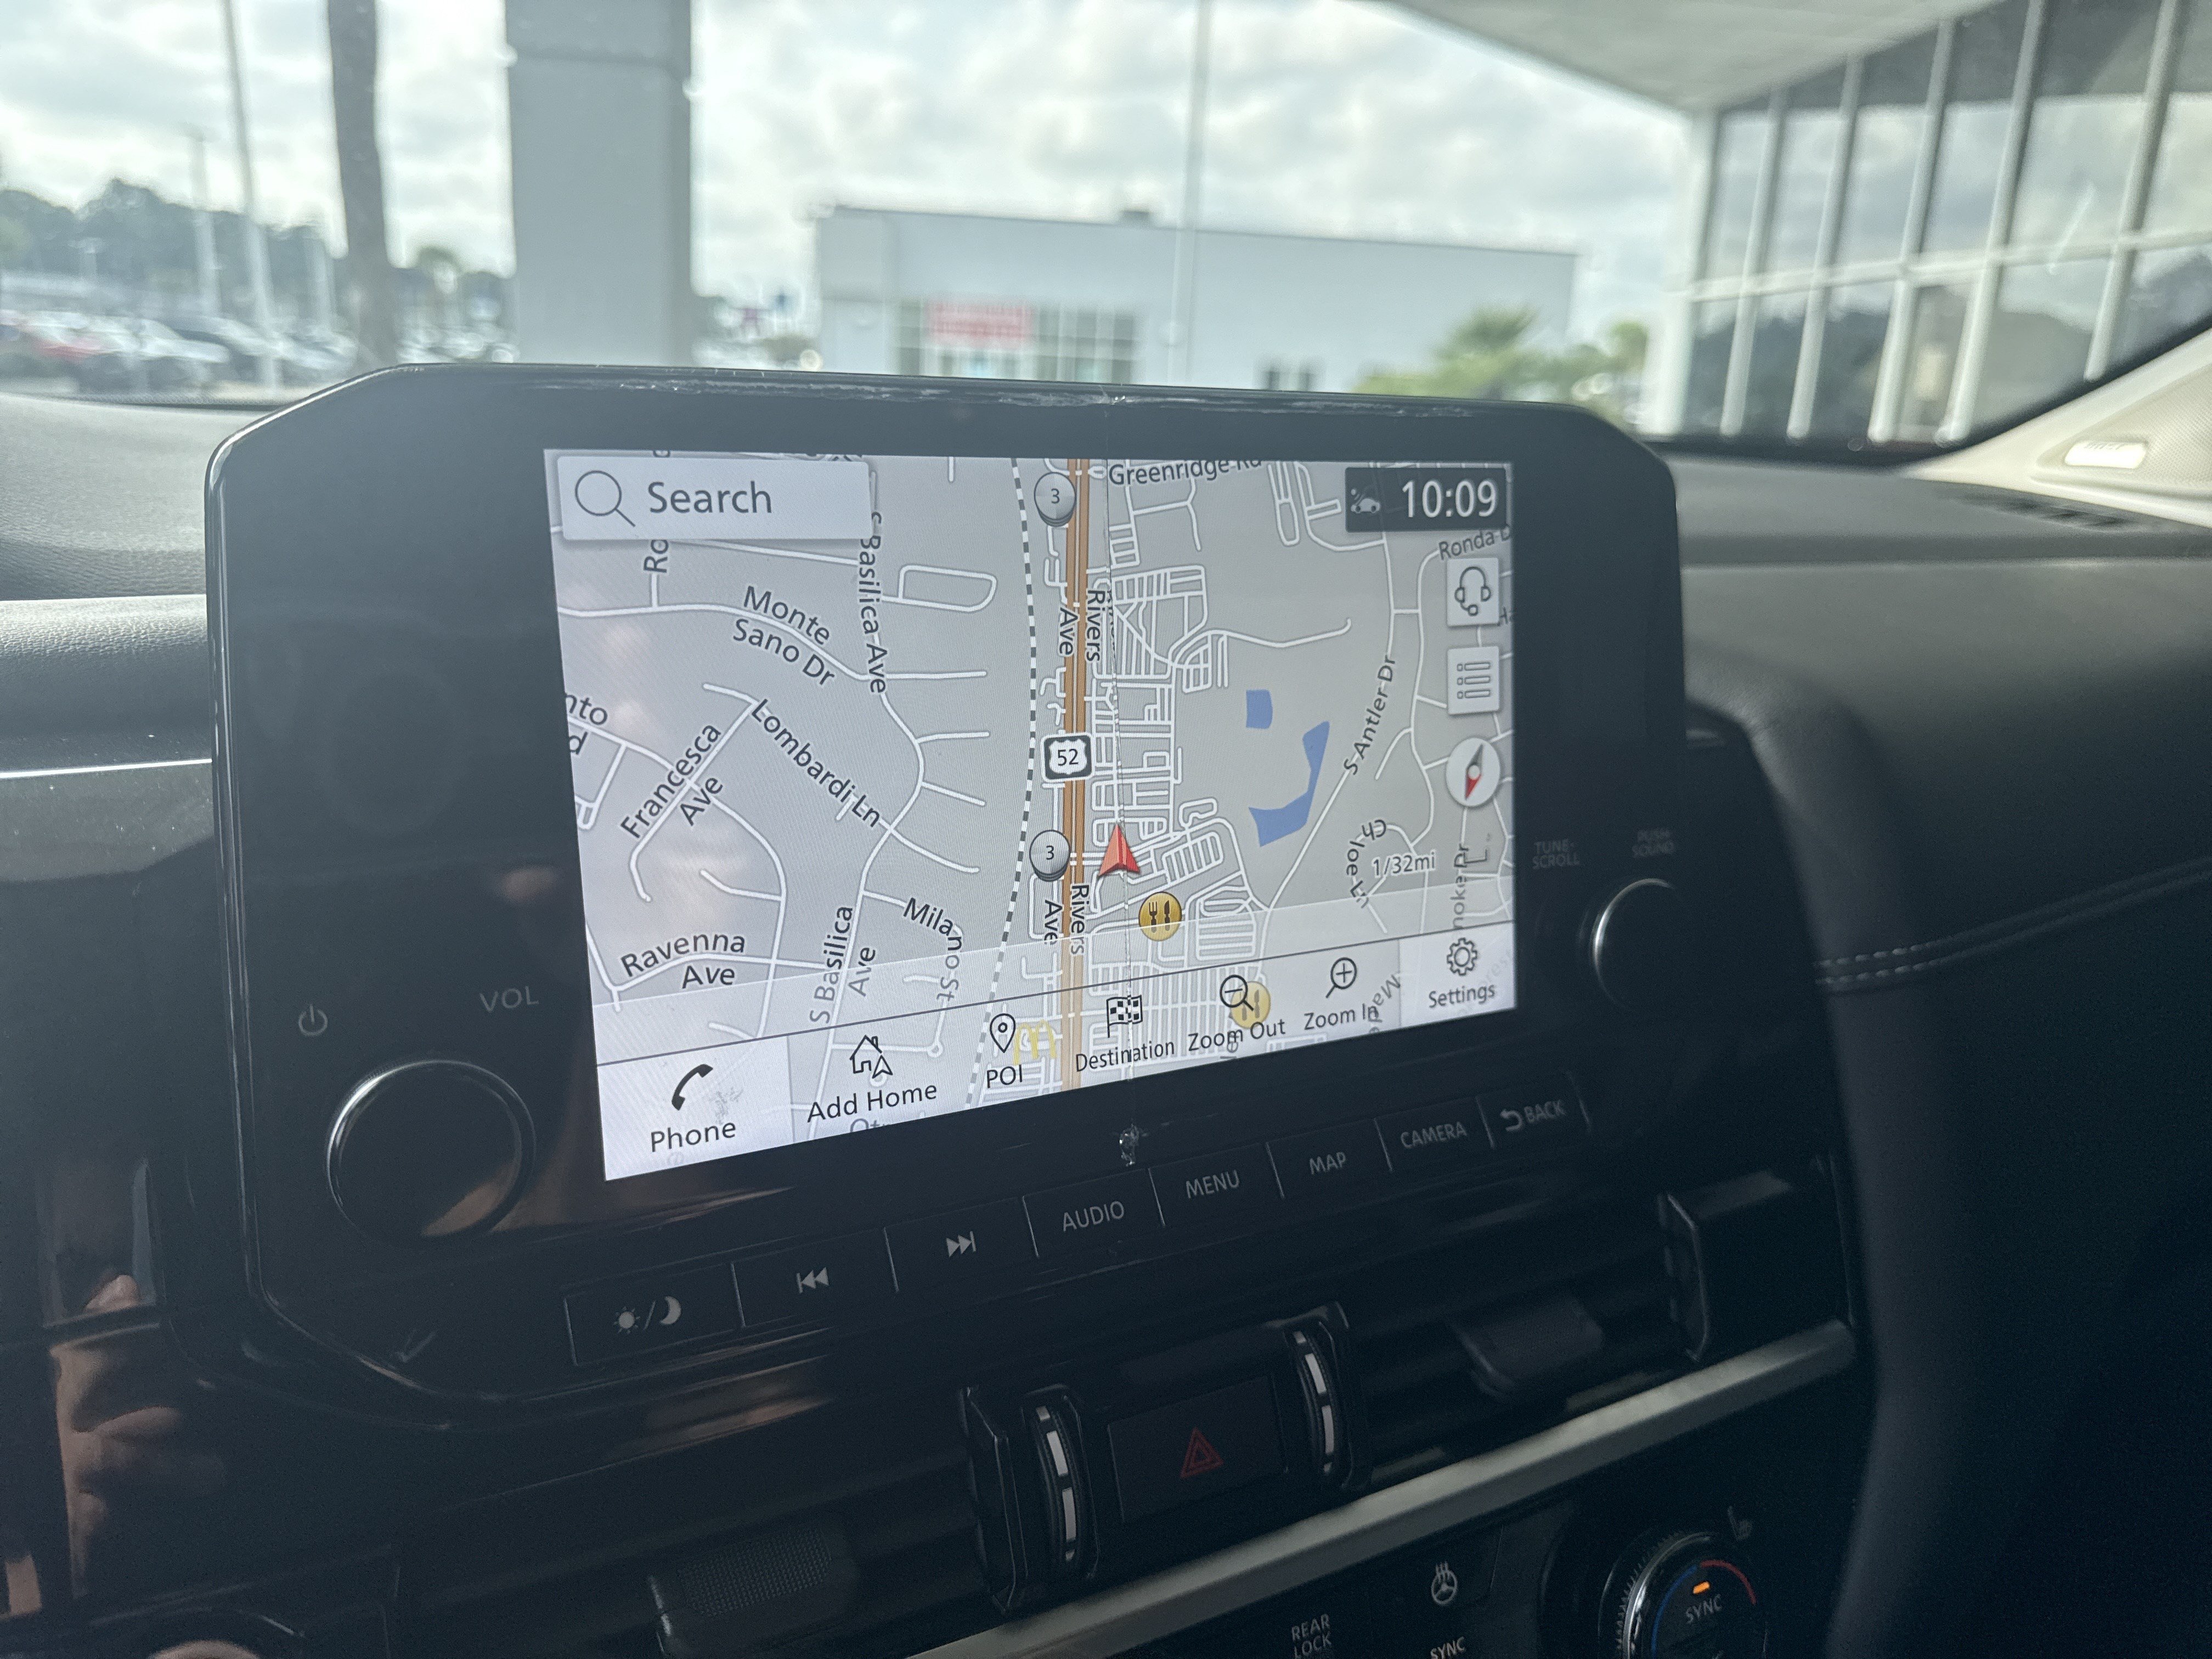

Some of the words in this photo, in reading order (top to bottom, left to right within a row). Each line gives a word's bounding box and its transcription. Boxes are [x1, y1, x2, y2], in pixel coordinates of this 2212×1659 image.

[1109, 460, 1229, 485] Greenridge
[648, 481, 772, 514] Search
[1050, 488, 1060, 504] 3
[1402, 479, 1497, 518] 10:09
[1438, 530, 1495, 560] Ronda
[859, 535, 882, 634] Basilica
[744, 585, 831, 645] Monte
[1087, 590, 1105, 662] Rivers
[1059, 607, 1079, 657] Ave
[733, 619, 799, 663] Sano
[802, 655, 835, 686] Dr
[867, 643, 888, 693] Ave
[1344, 758, 1358, 775] S
[1353, 687, 1388, 760] Antler
[1378, 654, 1396, 682] Dr
[751, 698, 855, 803] Lombardi
[851, 794, 881, 827] Ln
[1058, 748, 1078, 766] 52
[620, 725, 721, 838] Francesca
[679, 777, 724, 826] Ave
[1046, 845, 1054, 860] 3
[1346, 819, 1387, 876] Chloe
[1373, 851, 1436, 876] 1/32mi
[1454, 843, 1469, 868] Dr
[1532, 852, 1581, 870] SCROLL
[1350, 880, 1369, 909] Ln
[1043, 899, 1063, 945] Ave
[1071, 884, 1090, 955] Rivers
[621, 934, 746, 977] Ravenna
[814, 906, 853, 1001] Basilica
[903, 898, 963, 969] Milano
[936, 978, 958, 1002] St
[682, 968, 735, 989] Ave
[849, 947, 876, 997] Ave
[479, 986, 540, 1013] VOL
[1429, 985, 1496, 1008] Settings
[809, 1009, 831, 1024] S
[1304, 1011, 1356, 1030] Zoom
[1362, 1003, 1379, 1020] In
[1188, 1029, 1243, 1051] Zoom
[1250, 1019, 1286, 1040] Out
[1076, 1041, 1175, 1073] Destination
[986, 1065, 1023, 1088] POI
[807, 1092, 858, 1123] Add
[867, 1085, 937, 1111] Home
[1523, 1099, 1567, 1124] BACK
[651, 1121, 737, 1153] Phone
[1400, 1121, 1468, 1149] CAMERA
[1309, 1152, 1347, 1175] MAP
[1186, 1169, 1240, 1199] MENU
[1062, 1200, 1125, 1232] AUDIO
[1685, 1593, 1723, 1624] SYNC
[1291, 1613, 1330, 1641] REAR
[1294, 1631, 1332, 1659] LOCK
[1430, 1636, 1467, 1659] SYNC
